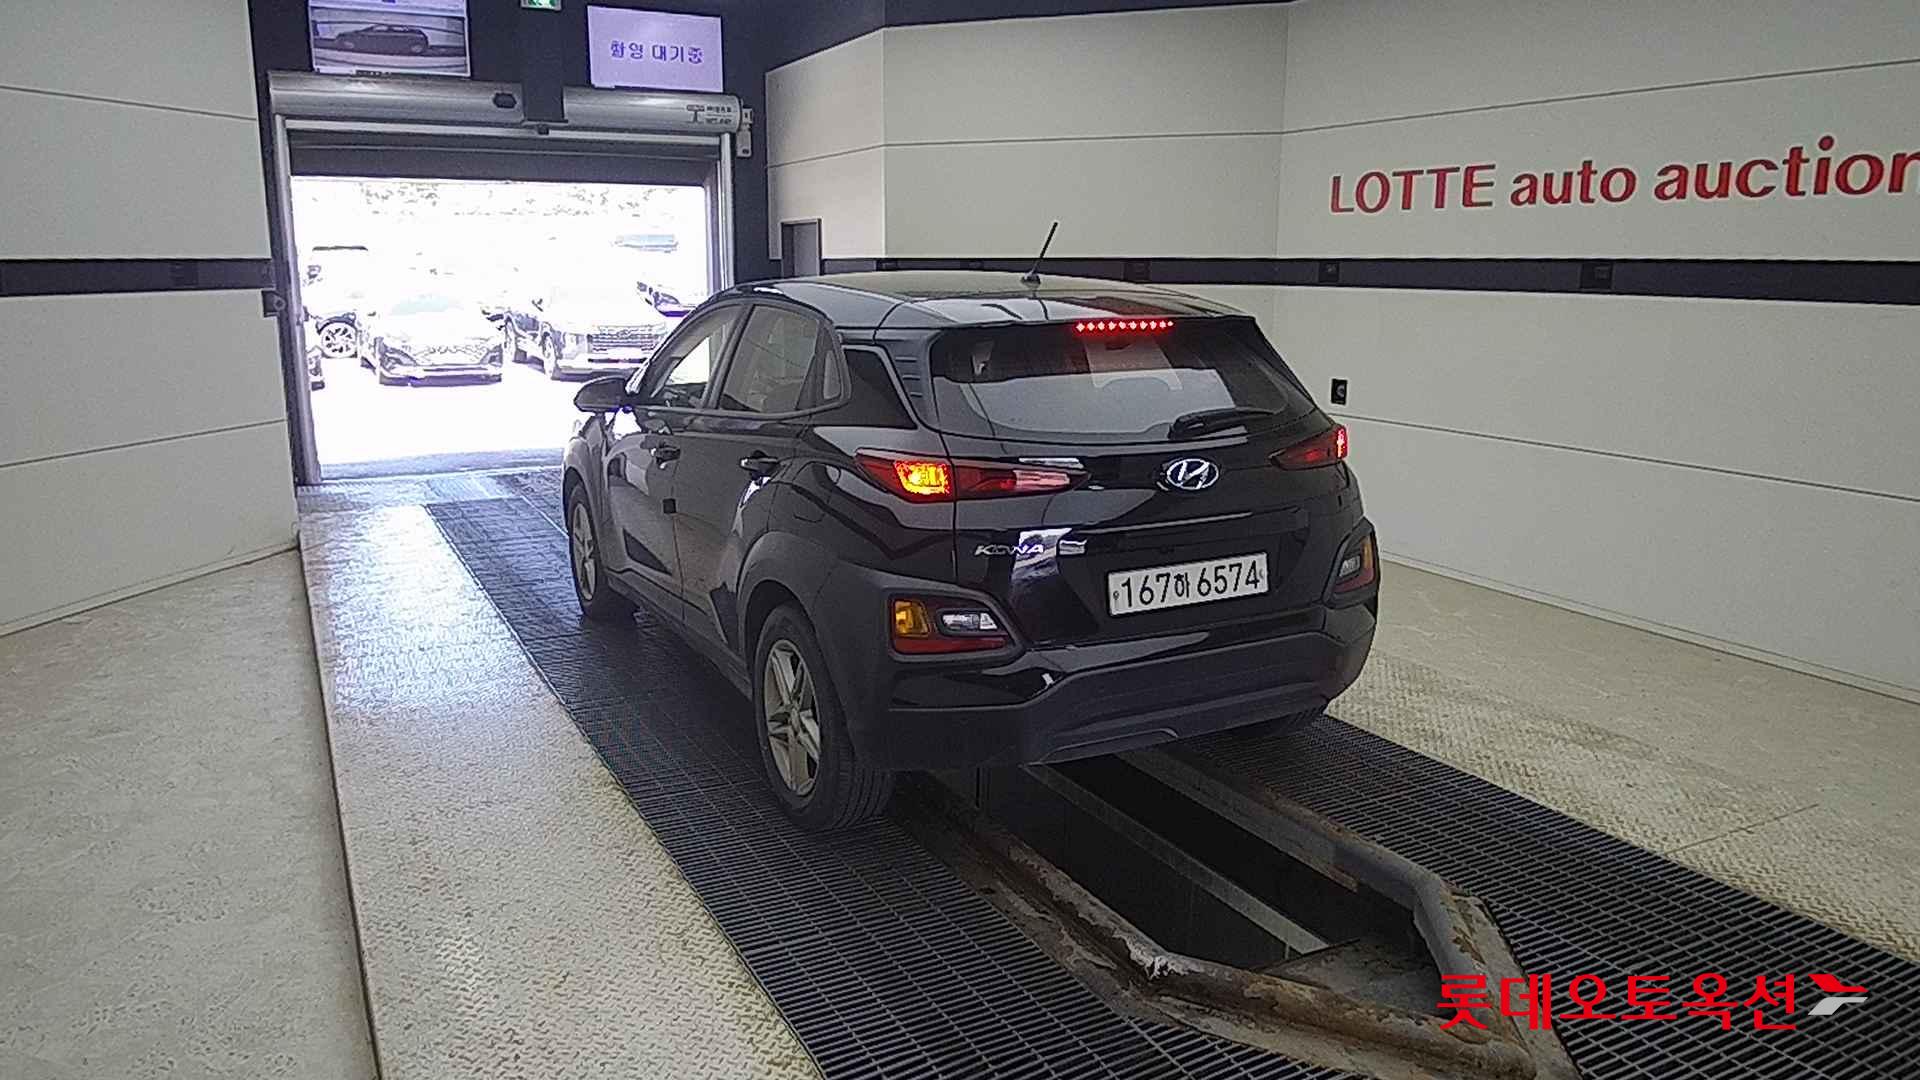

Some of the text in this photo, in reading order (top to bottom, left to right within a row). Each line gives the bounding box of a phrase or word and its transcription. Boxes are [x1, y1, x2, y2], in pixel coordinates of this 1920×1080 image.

[651, 44, 705, 65] 대기중
[1330, 164, 1497, 213] LOTTE
[1510, 159, 1638, 206] auto
